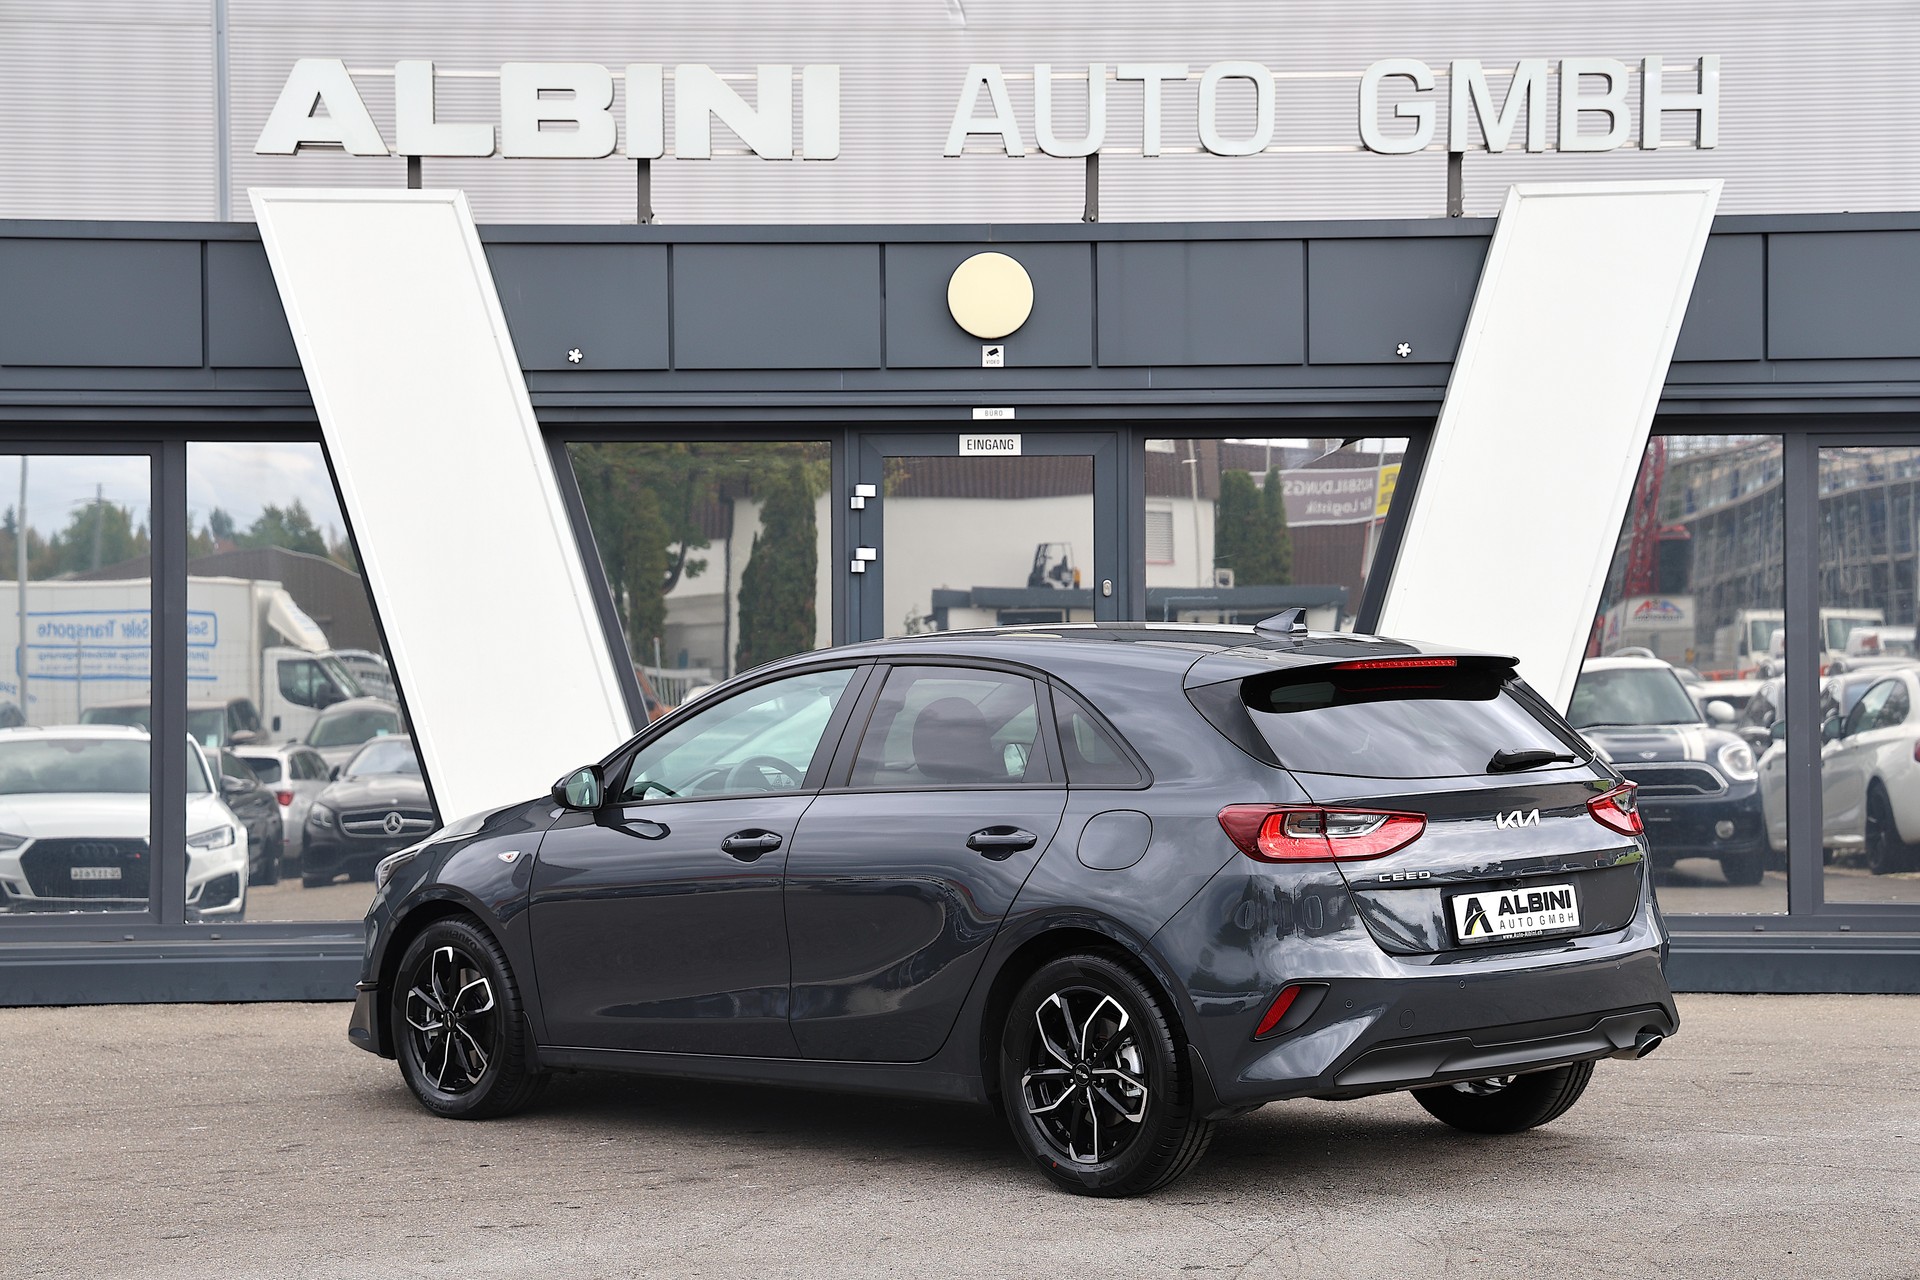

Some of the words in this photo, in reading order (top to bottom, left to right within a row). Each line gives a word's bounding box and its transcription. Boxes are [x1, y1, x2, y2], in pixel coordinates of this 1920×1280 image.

[254, 59, 840, 161] ALBINI
[943, 61, 1275, 158] AUTO
[1359, 55, 1721, 155] GMBH
[984, 409, 1004, 417] BÜRO
[966, 439, 1014, 450] EINGANG
[1496, 808, 1540, 830] KIA
[1378, 870, 1431, 883] CEED
[1498, 889, 1572, 917] ALBINI
[1499, 916, 1534, 930] AUTO
[1539, 912, 1575, 926] GMBH
